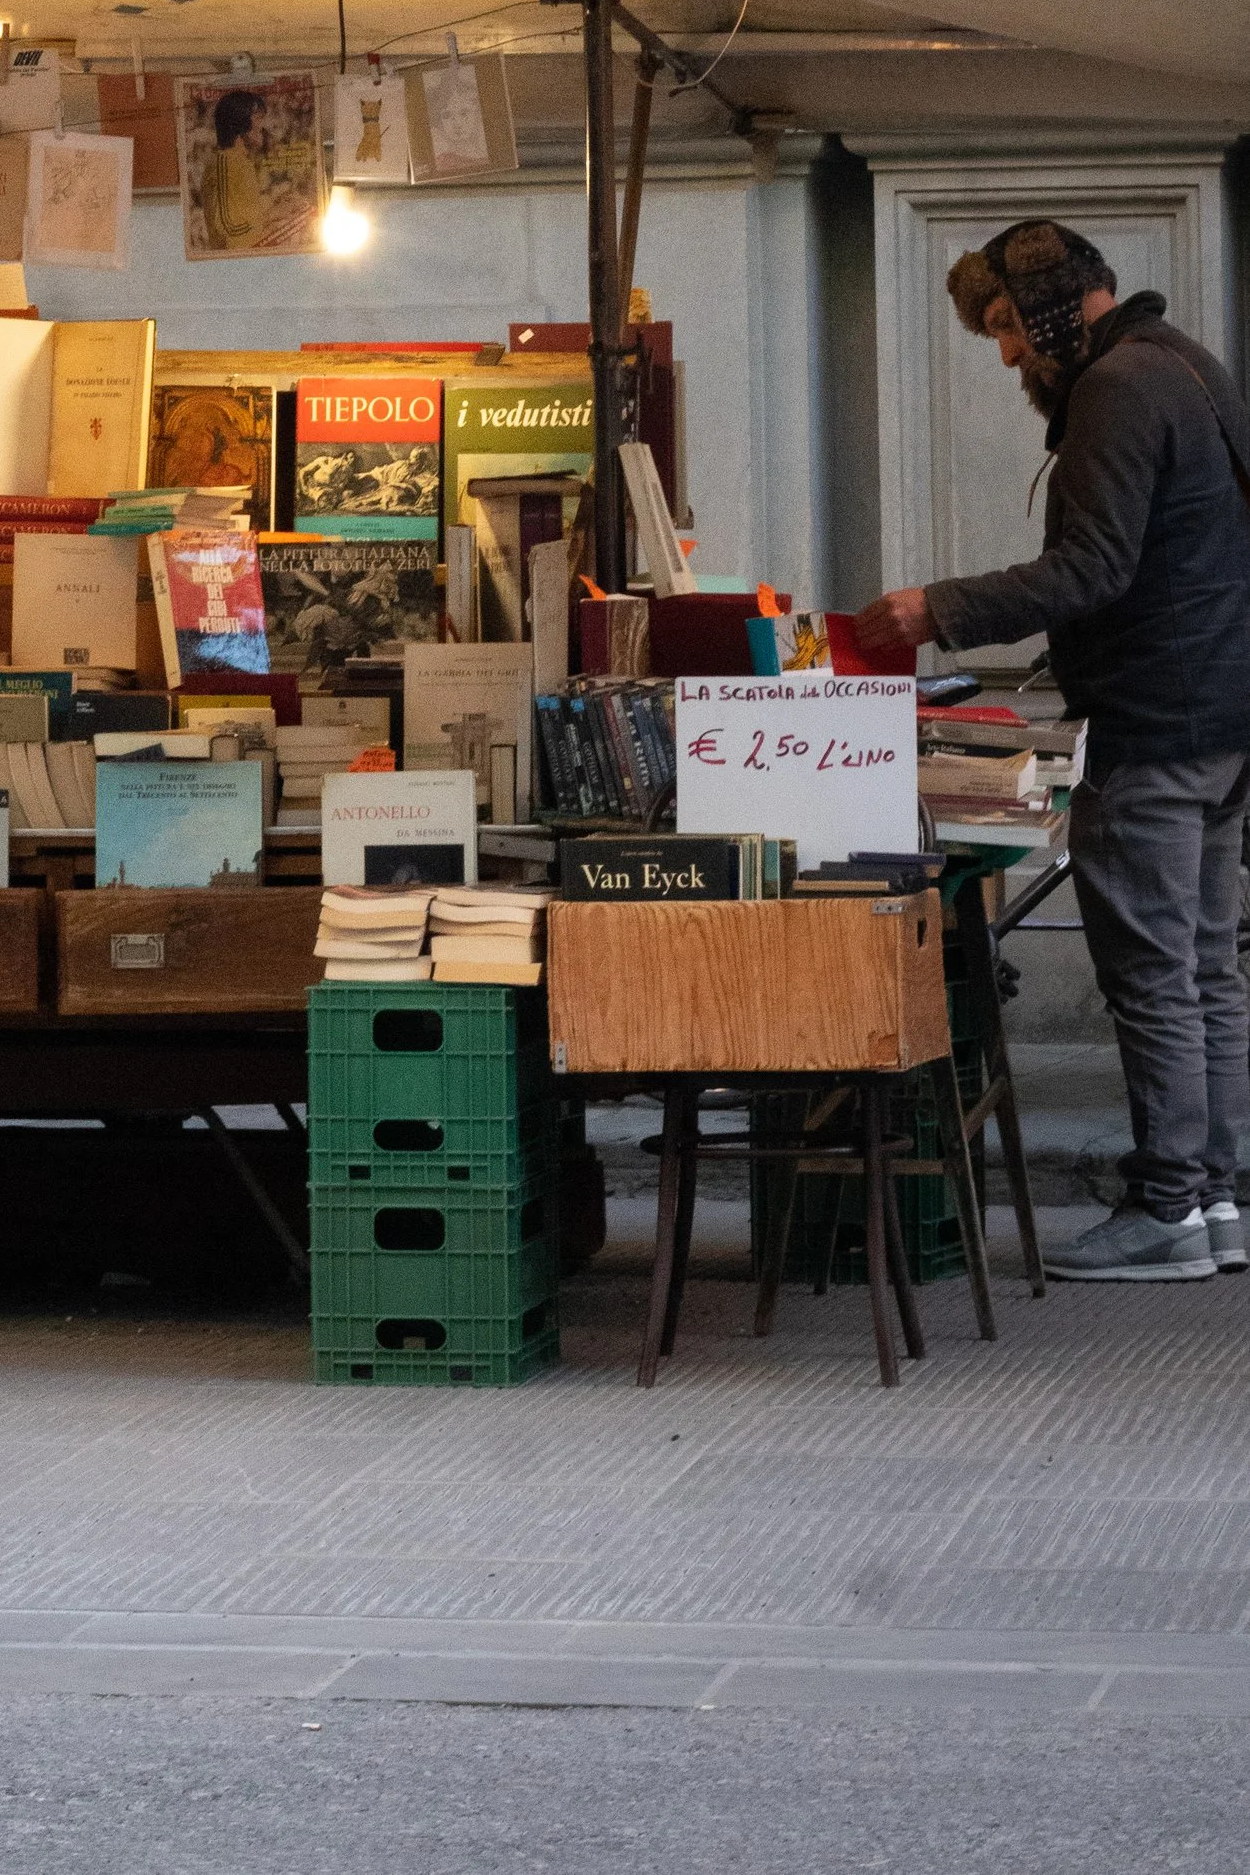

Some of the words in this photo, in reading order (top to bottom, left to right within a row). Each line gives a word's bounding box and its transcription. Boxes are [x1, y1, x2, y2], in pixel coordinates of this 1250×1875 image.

[303, 396, 435, 423] TIEPOLO
[456, 399, 469, 428] i
[480, 398, 594, 427] vedutisti
[260, 549, 281, 561] LA
[283, 548, 350, 561] PITTURA
[355, 546, 432, 560] ITALIANA
[260, 559, 313, 573] NELLA
[313, 558, 395, 572] FOTOTECA
[397, 558, 432, 571] ZERI
[55, 583, 101, 594] ANNALI
[680, 681, 710, 702] LA
[823, 679, 912, 699] OCCASIONI
[688, 728, 727, 765] €
[329, 805, 432, 822] ANTONELLO
[396, 828, 411, 838] DA
[414, 827, 455, 838] MESSINA
[580, 863, 631, 890] Van
[641, 863, 707, 896] Eyck
